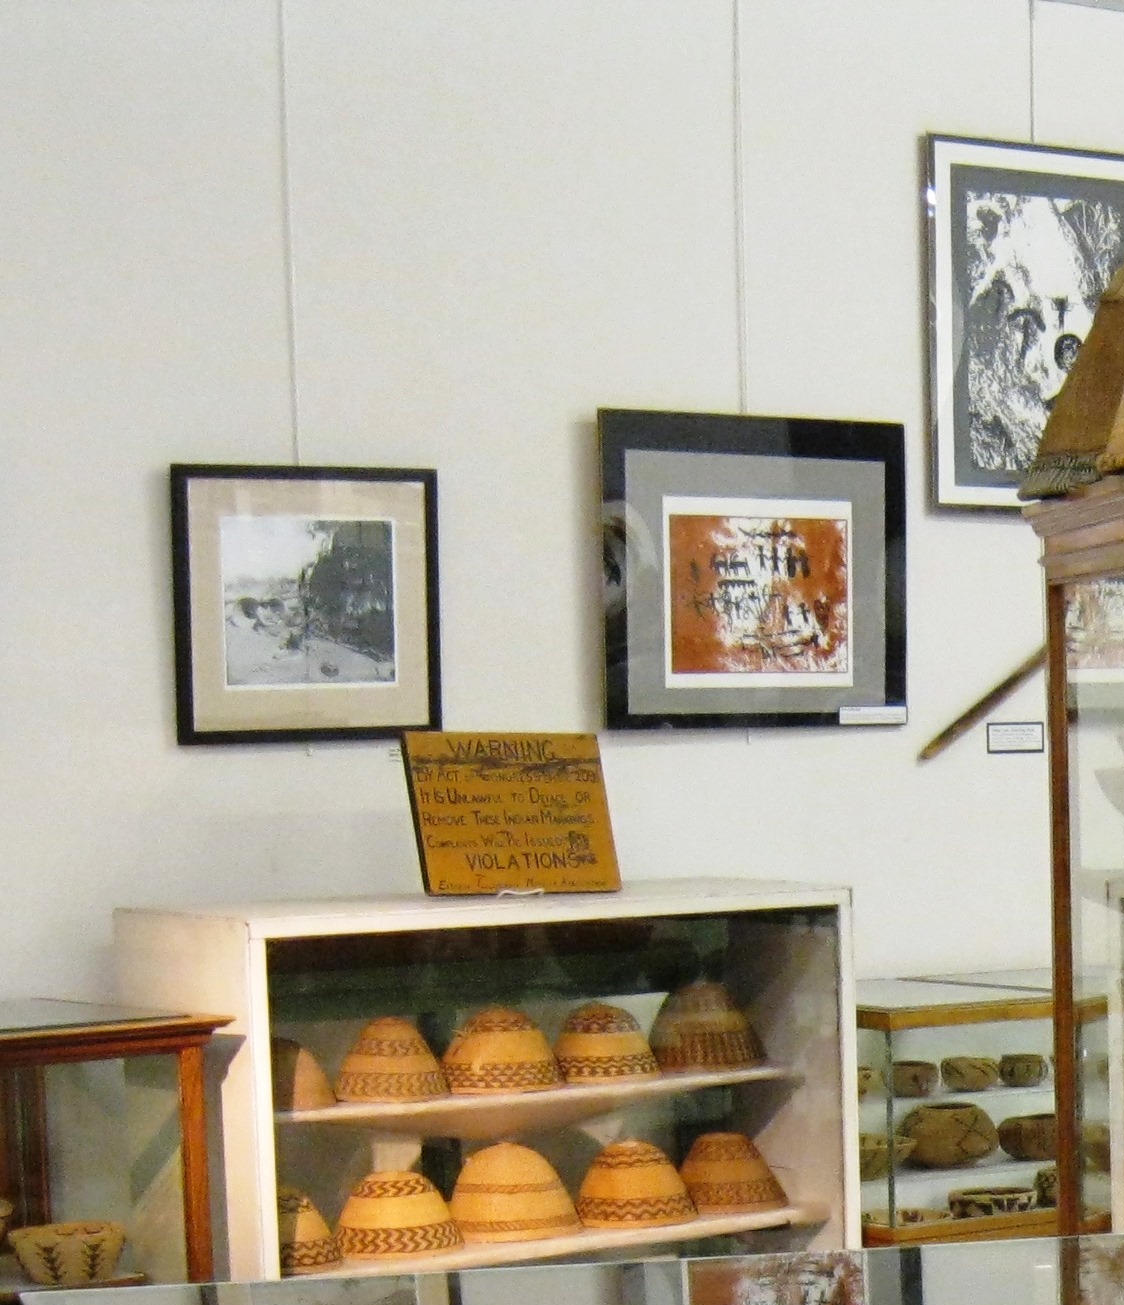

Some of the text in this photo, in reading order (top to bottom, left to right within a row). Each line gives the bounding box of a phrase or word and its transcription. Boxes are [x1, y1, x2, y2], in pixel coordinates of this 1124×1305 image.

[446, 738, 556, 763] WARNING
[437, 766, 459, 783] ACT
[420, 787, 430, 804] IT
[434, 787, 445, 804] IS
[511, 791, 525, 803] TO
[575, 791, 590, 803] OR
[422, 811, 467, 826] REMOVE
[471, 809, 501, 826] THESE
[503, 809, 539, 825] INDIAN
[465, 852, 580, 872] VIOLATIONS
